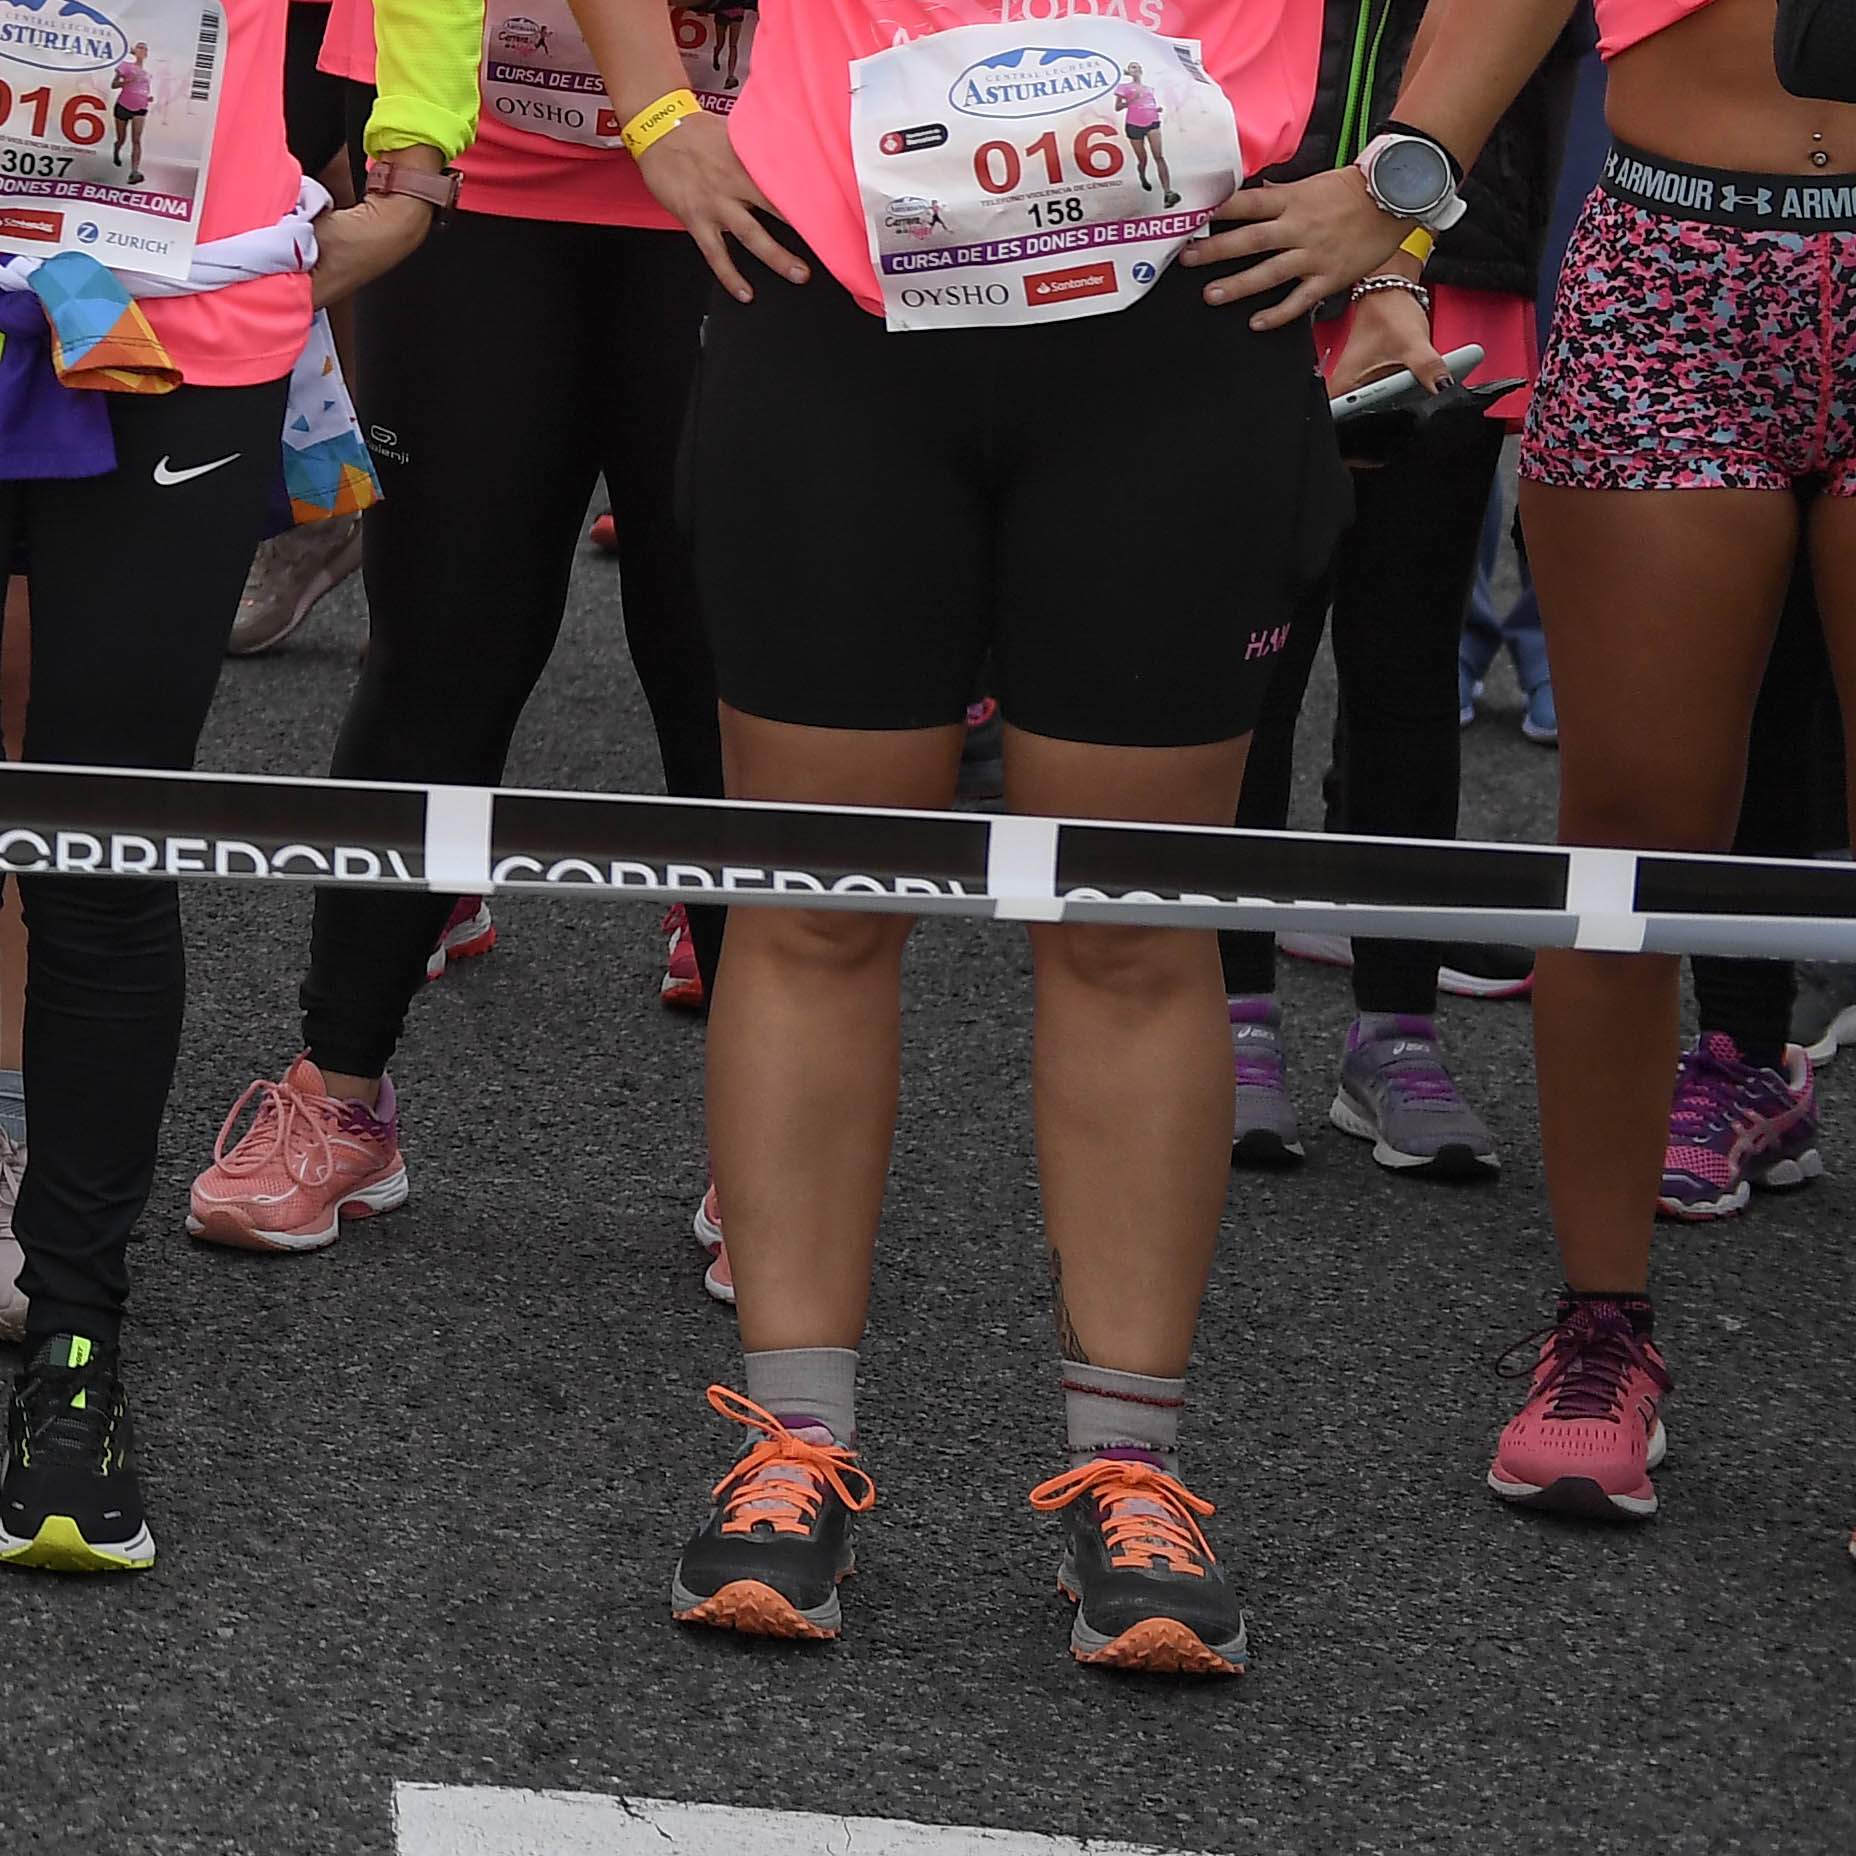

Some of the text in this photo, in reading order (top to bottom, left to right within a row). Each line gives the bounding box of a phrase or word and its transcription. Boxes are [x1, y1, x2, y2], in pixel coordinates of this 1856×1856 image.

[496, 65, 604, 92] CURSA DE LES
[962, 70, 1108, 108] ASTURIANA
[496, 96, 584, 128] OYSHO
[640, 104, 676, 132] TURNO
[973, 123, 1125, 195] 016
[54, 181, 81, 197] DE
[84, 183, 188, 217] BARCELONA
[1615, 156, 1714, 211] ARMOUR
[1027, 197, 1084, 229] 158
[105, 231, 168, 255] ZURICH
[892, 209, 1216, 271] CURSA DE LES DONES DE BARCELO
[901, 272, 1105, 308] OYSHO Santander
